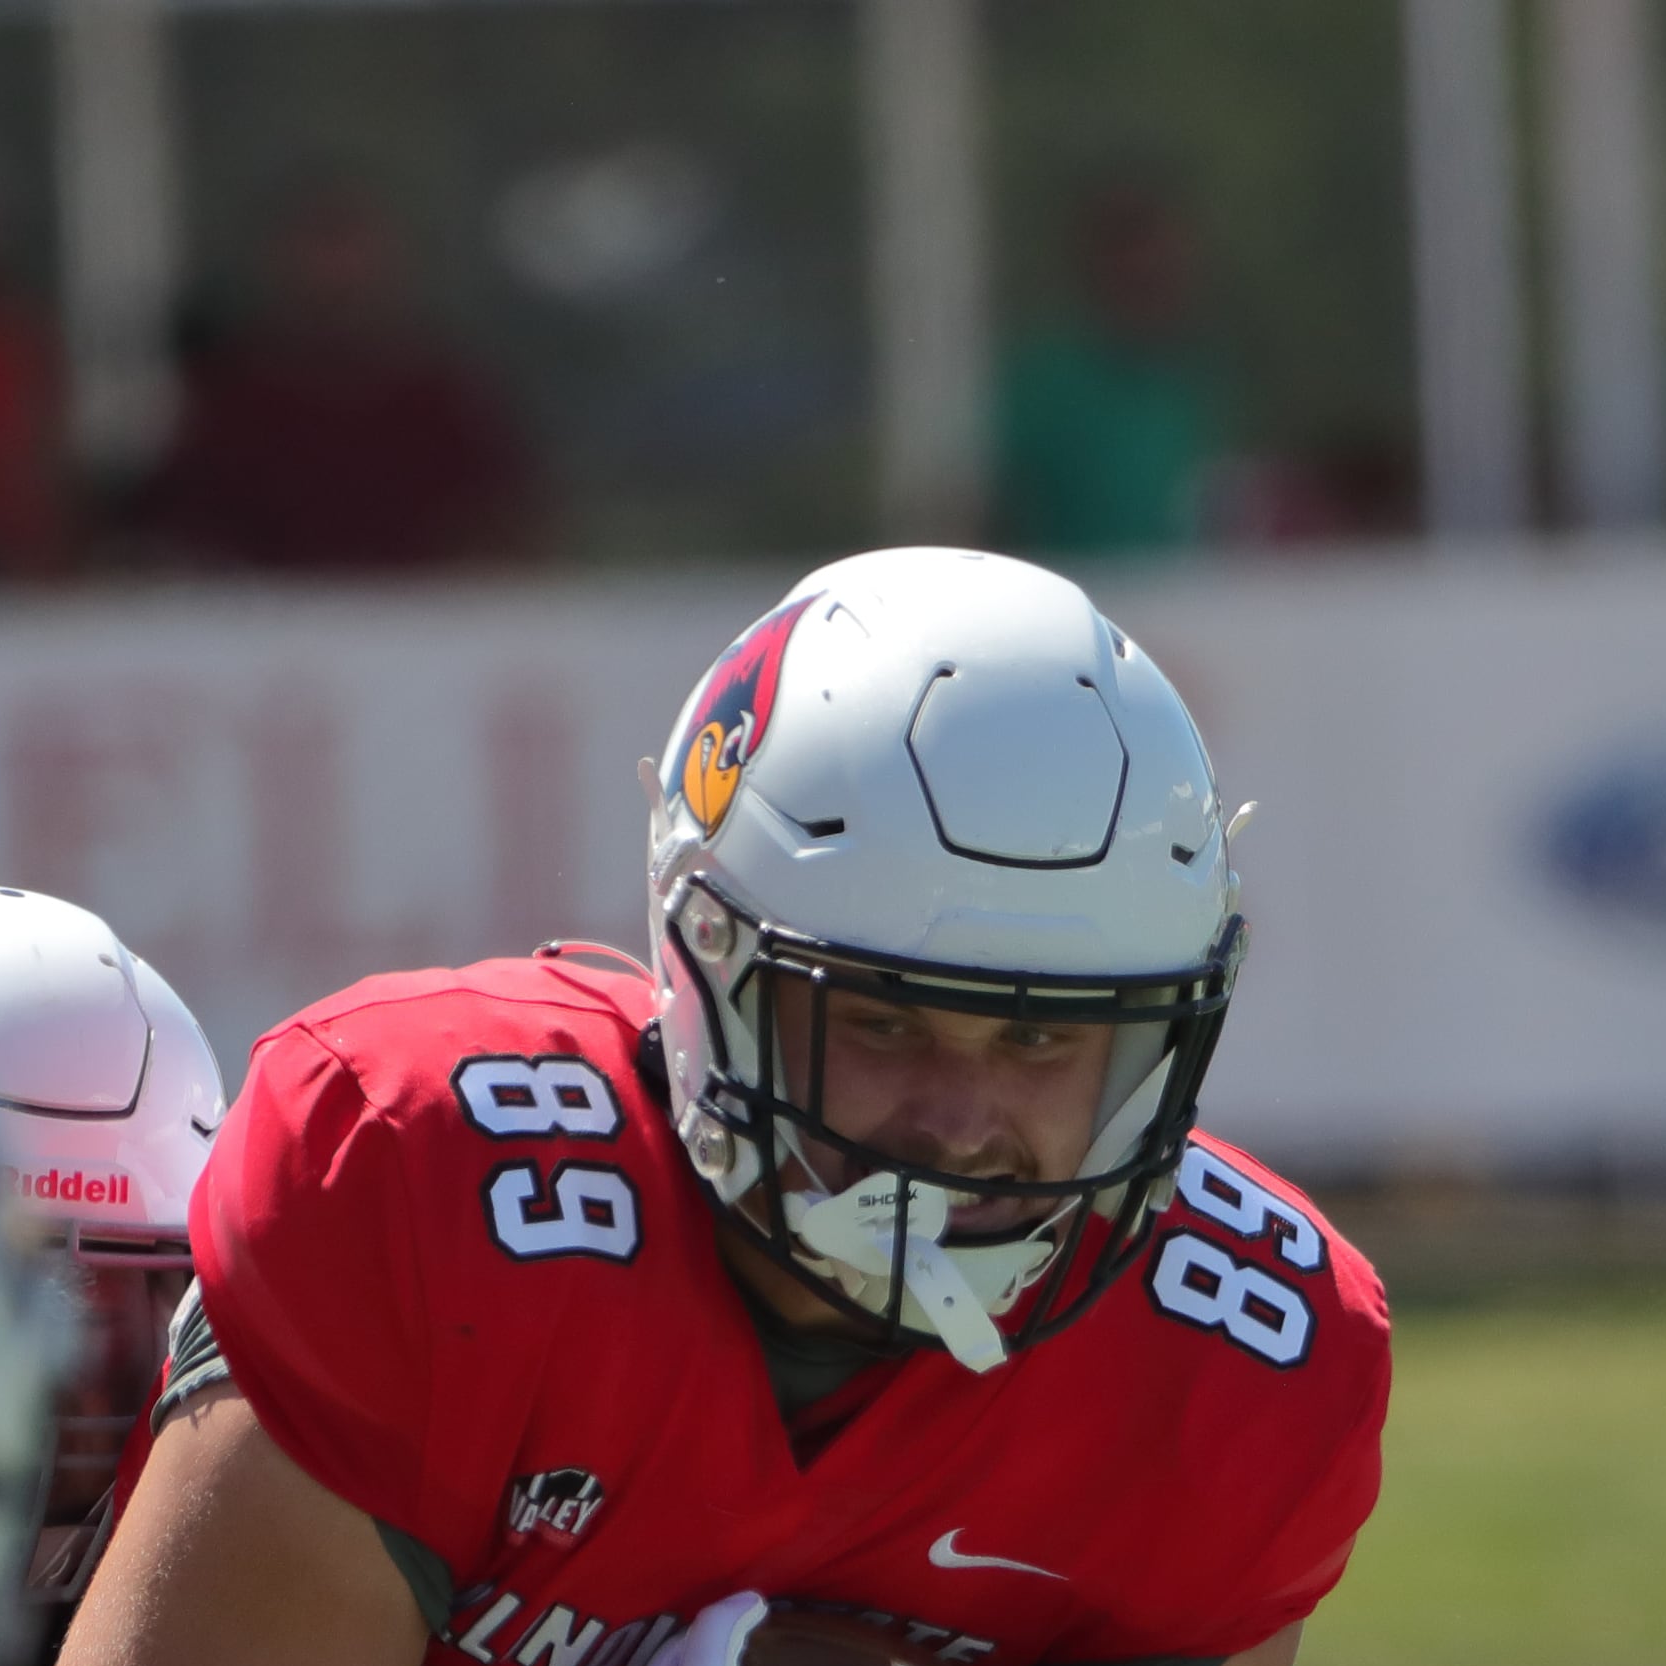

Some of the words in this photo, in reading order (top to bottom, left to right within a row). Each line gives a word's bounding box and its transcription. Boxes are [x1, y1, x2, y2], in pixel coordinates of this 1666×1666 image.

[448, 1053, 646, 1267] 89
[858, 1188, 918, 1208] SHOK
[1142, 1138, 1327, 1372] 89
